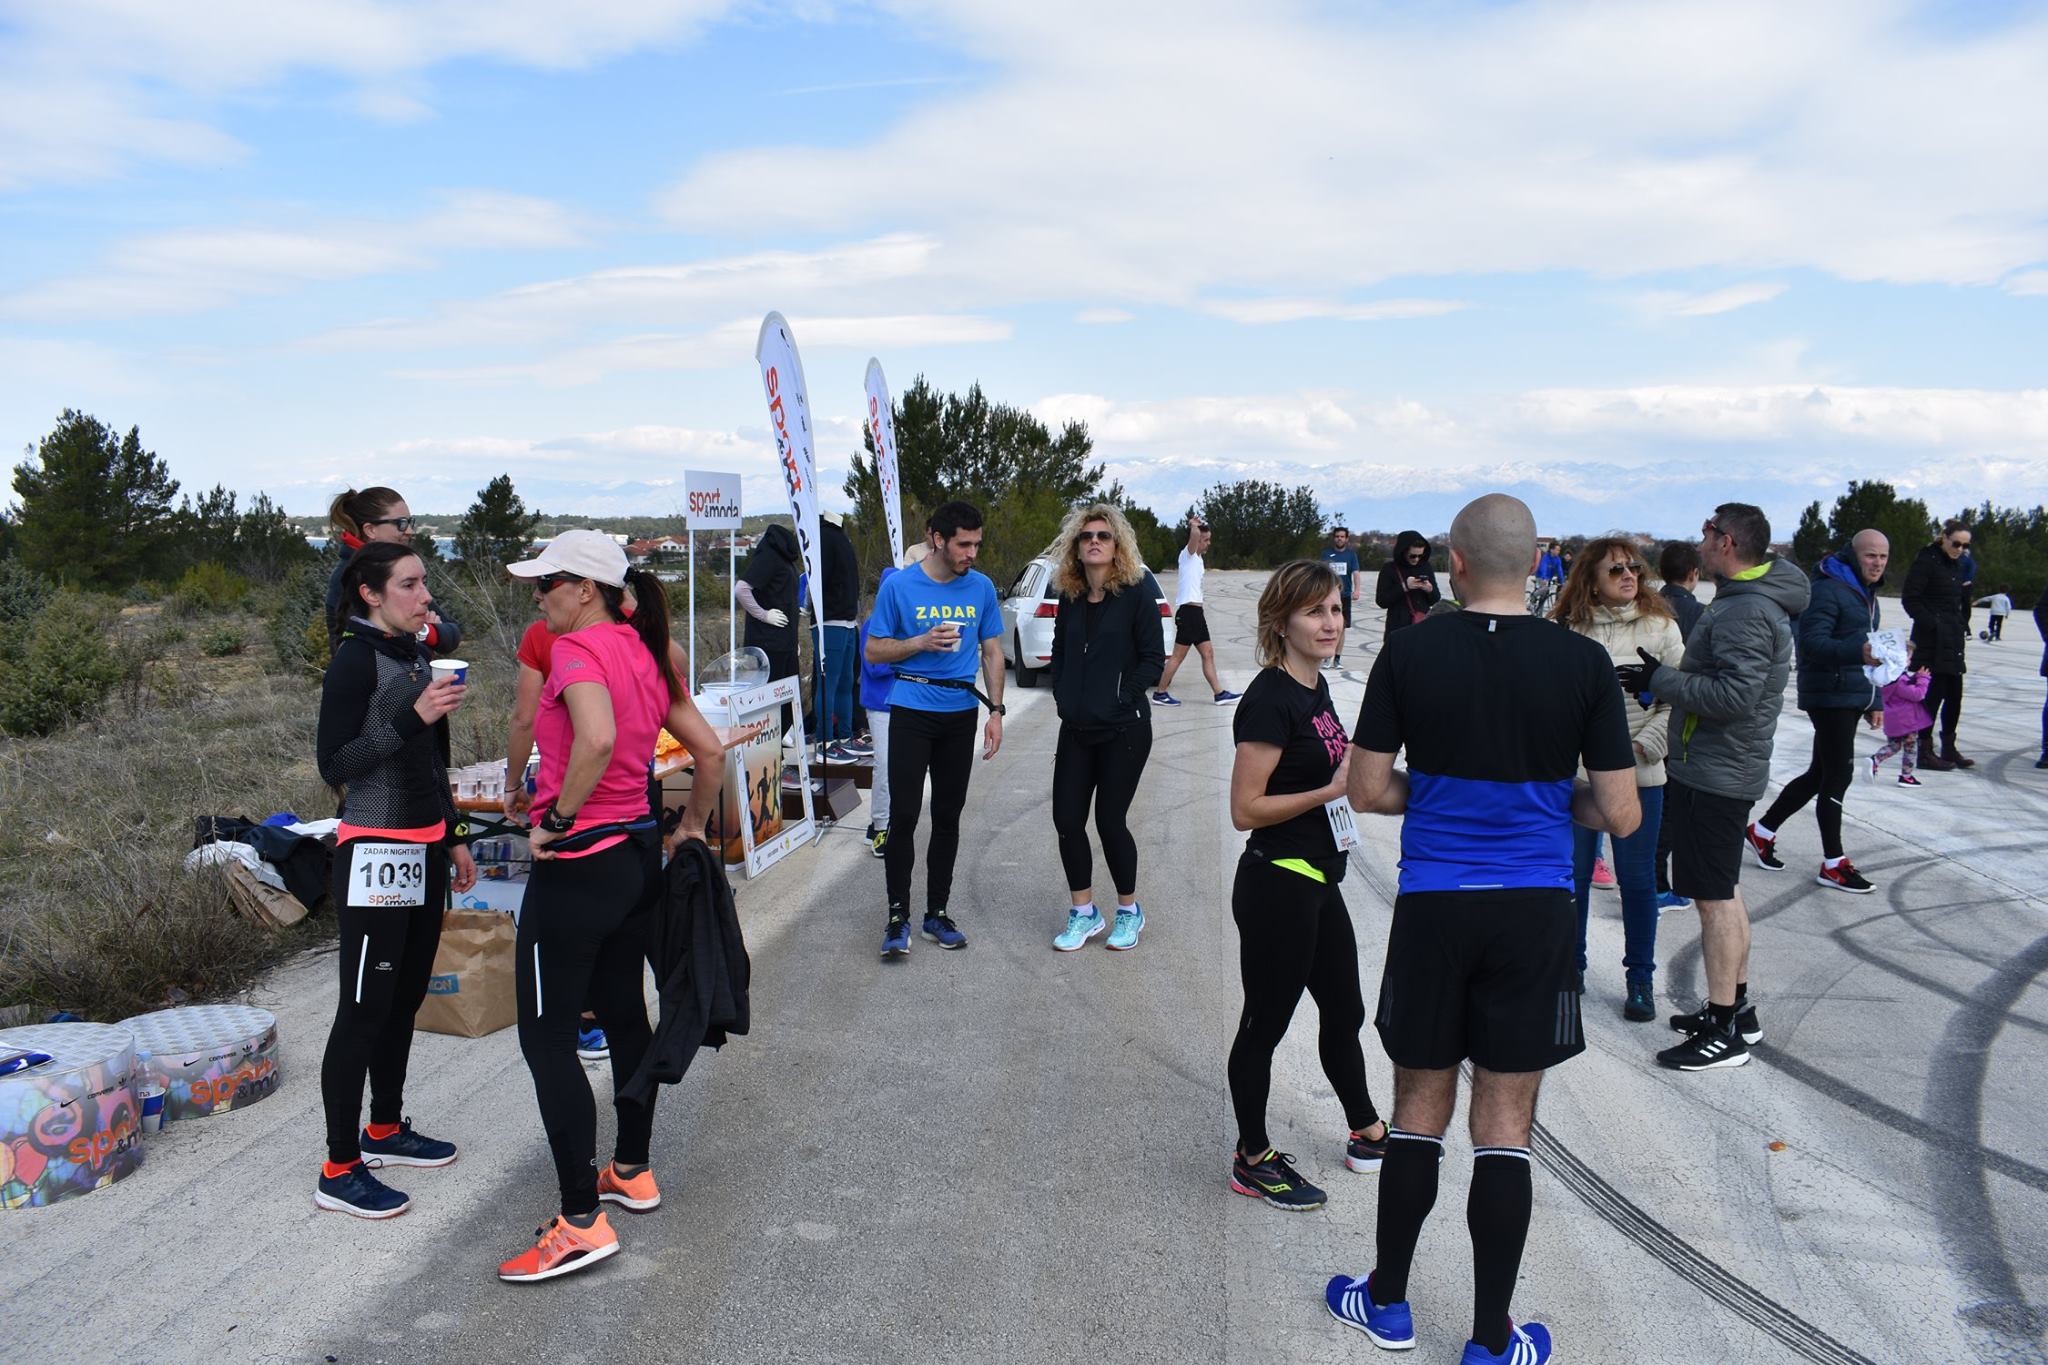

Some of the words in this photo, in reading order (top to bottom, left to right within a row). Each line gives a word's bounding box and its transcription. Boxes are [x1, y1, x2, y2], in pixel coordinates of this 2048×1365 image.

[689, 487, 720, 517] sport
[704, 498, 739, 518] &moda
[916, 605, 977, 619] ZADAR
[1330, 804, 1353, 833] 1171
[363, 847, 389, 855] ZADAR
[389, 848, 410, 856] NIGHT
[360, 862, 422, 888] 1039
[368, 892, 401, 905] sport
[191, 1057, 273, 1105] sport
